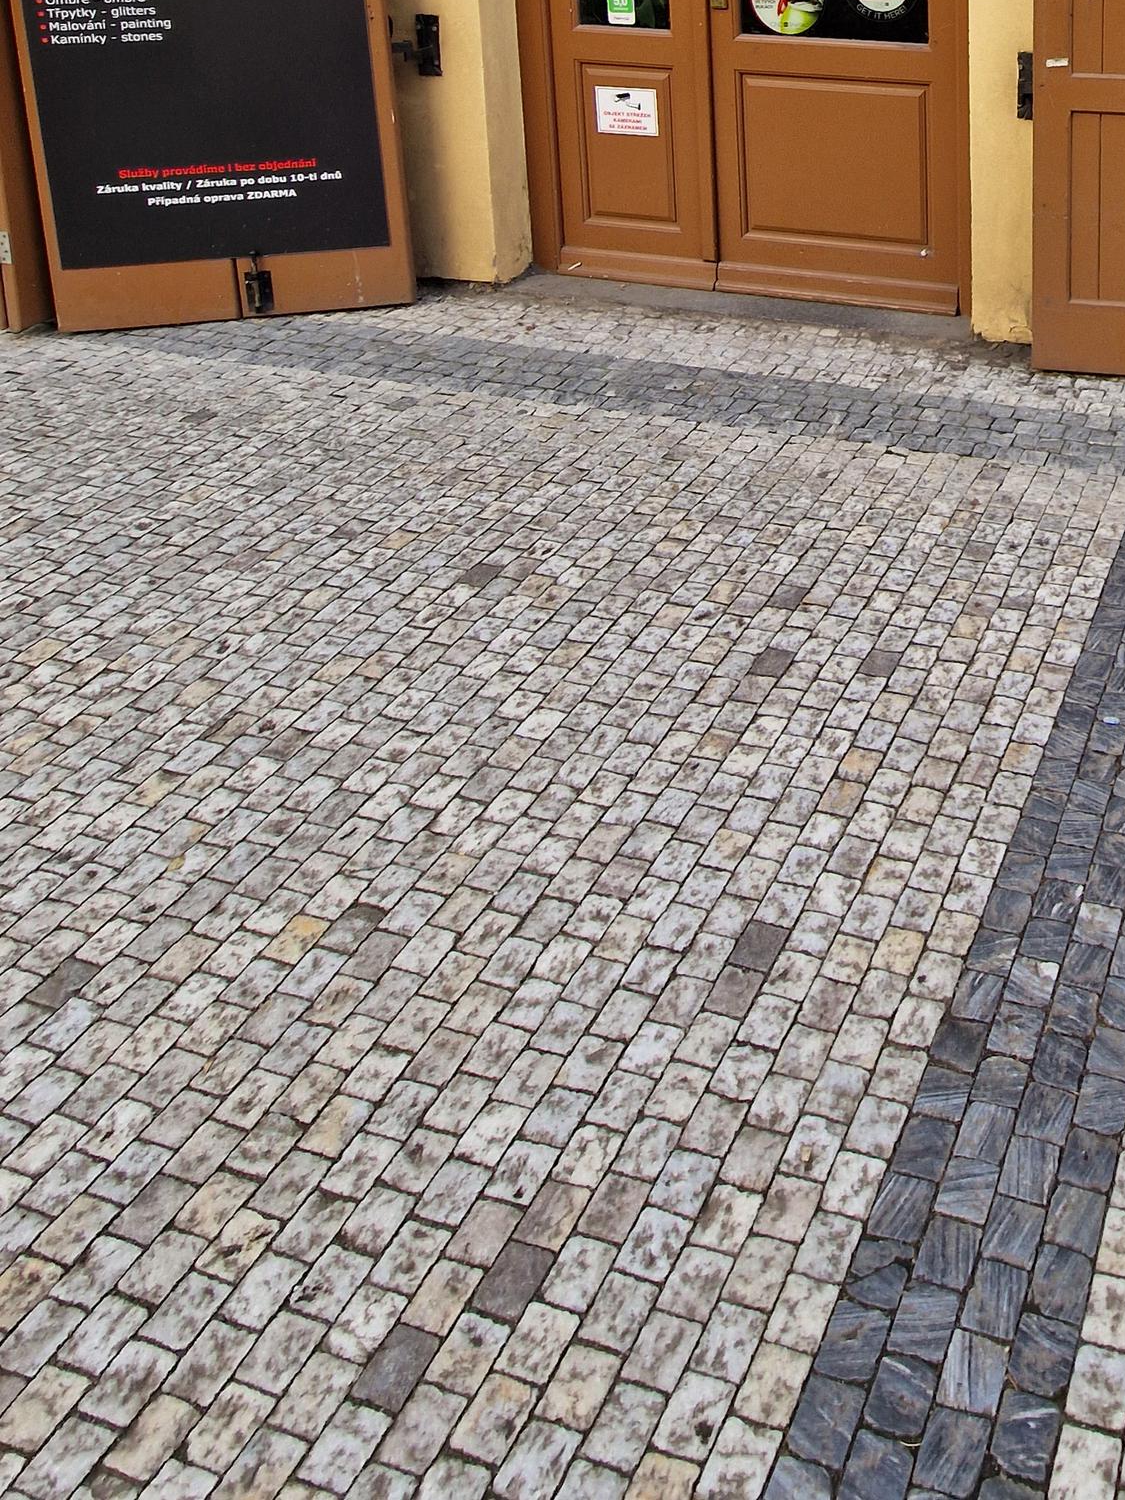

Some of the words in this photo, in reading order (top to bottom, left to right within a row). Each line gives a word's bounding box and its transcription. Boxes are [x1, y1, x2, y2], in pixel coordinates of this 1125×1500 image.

[46, 7, 96, 19] Třpytky
[111, 6, 156, 18] glitters
[856, 4, 871, 16] GET
[49, 20, 106, 32] Malování
[121, 19, 172, 30] painting
[50, 33, 106, 45] Kamínky
[121, 32, 163, 42] stones
[119, 169, 158, 179] Služby
[235, 162, 255, 172] bez
[259, 158, 316, 171] objednání
[96, 182, 139, 194] Záruka
[142, 181, 182, 192] kvality
[196, 177, 237, 189] Záruka
[240, 178, 255, 187] po
[258, 175, 286, 185] dobu
[148, 195, 200, 208] Případná
[204, 193, 244, 204] oprava
[247, 188, 297, 200] ZDARMA
